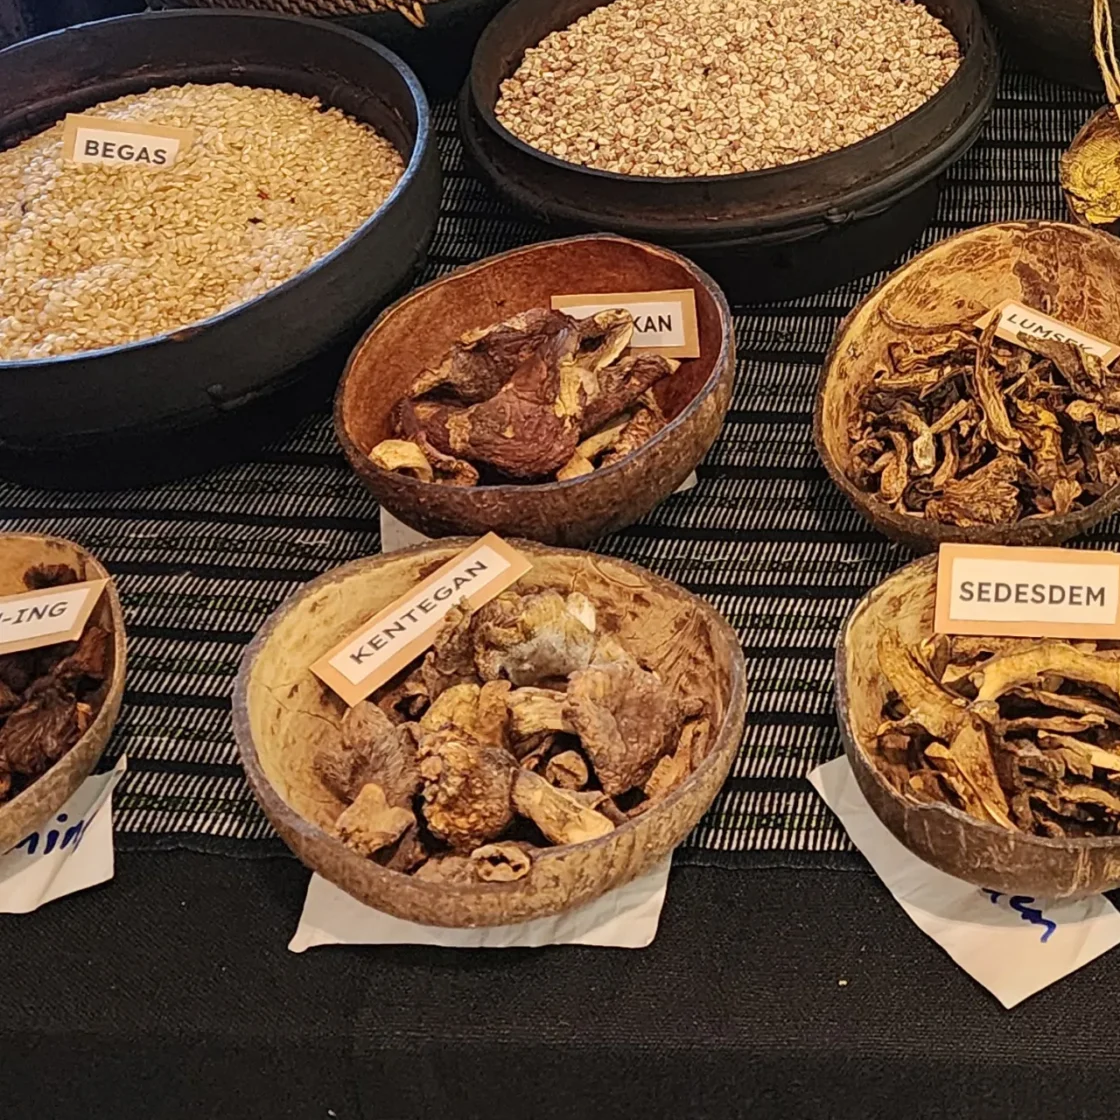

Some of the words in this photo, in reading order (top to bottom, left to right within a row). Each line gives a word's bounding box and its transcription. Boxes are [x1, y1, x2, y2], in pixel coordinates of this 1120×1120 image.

[84, 139, 167, 165] BEGAS
[959, 581, 1106, 607] SEDESDEM
[349, 560, 488, 665] KENTEGAN
